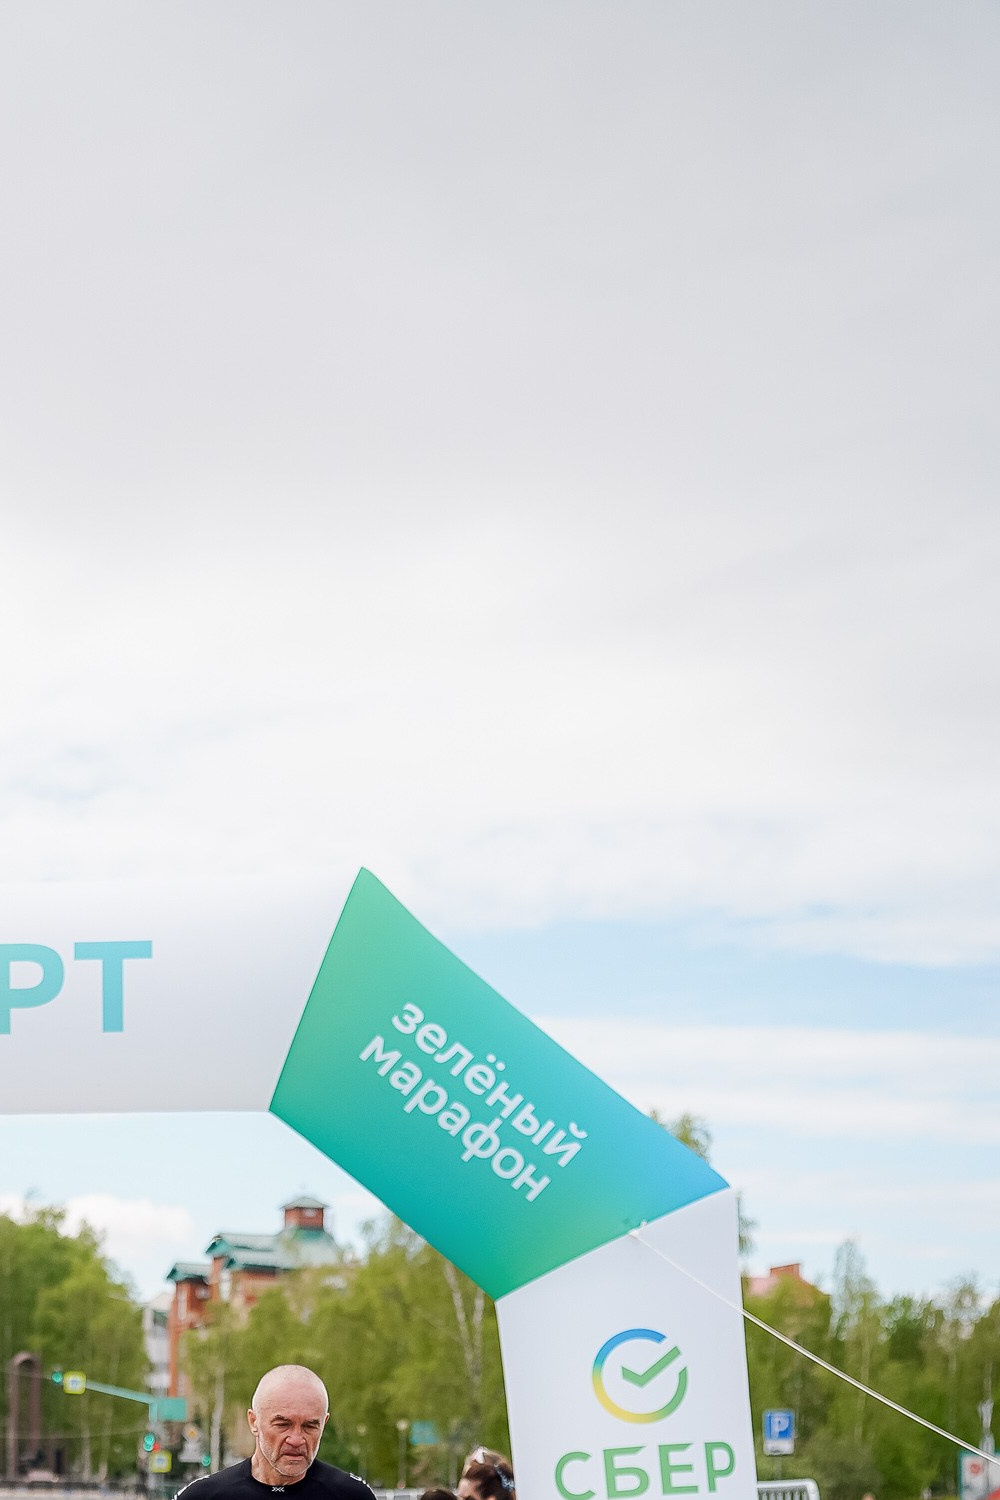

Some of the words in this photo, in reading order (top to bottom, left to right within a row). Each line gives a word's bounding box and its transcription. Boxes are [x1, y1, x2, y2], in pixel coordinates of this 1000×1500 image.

[358, 1034, 551, 1202] марафон
[391, 1002, 589, 1168] зелёный
[770, 1412, 790, 1439] P
